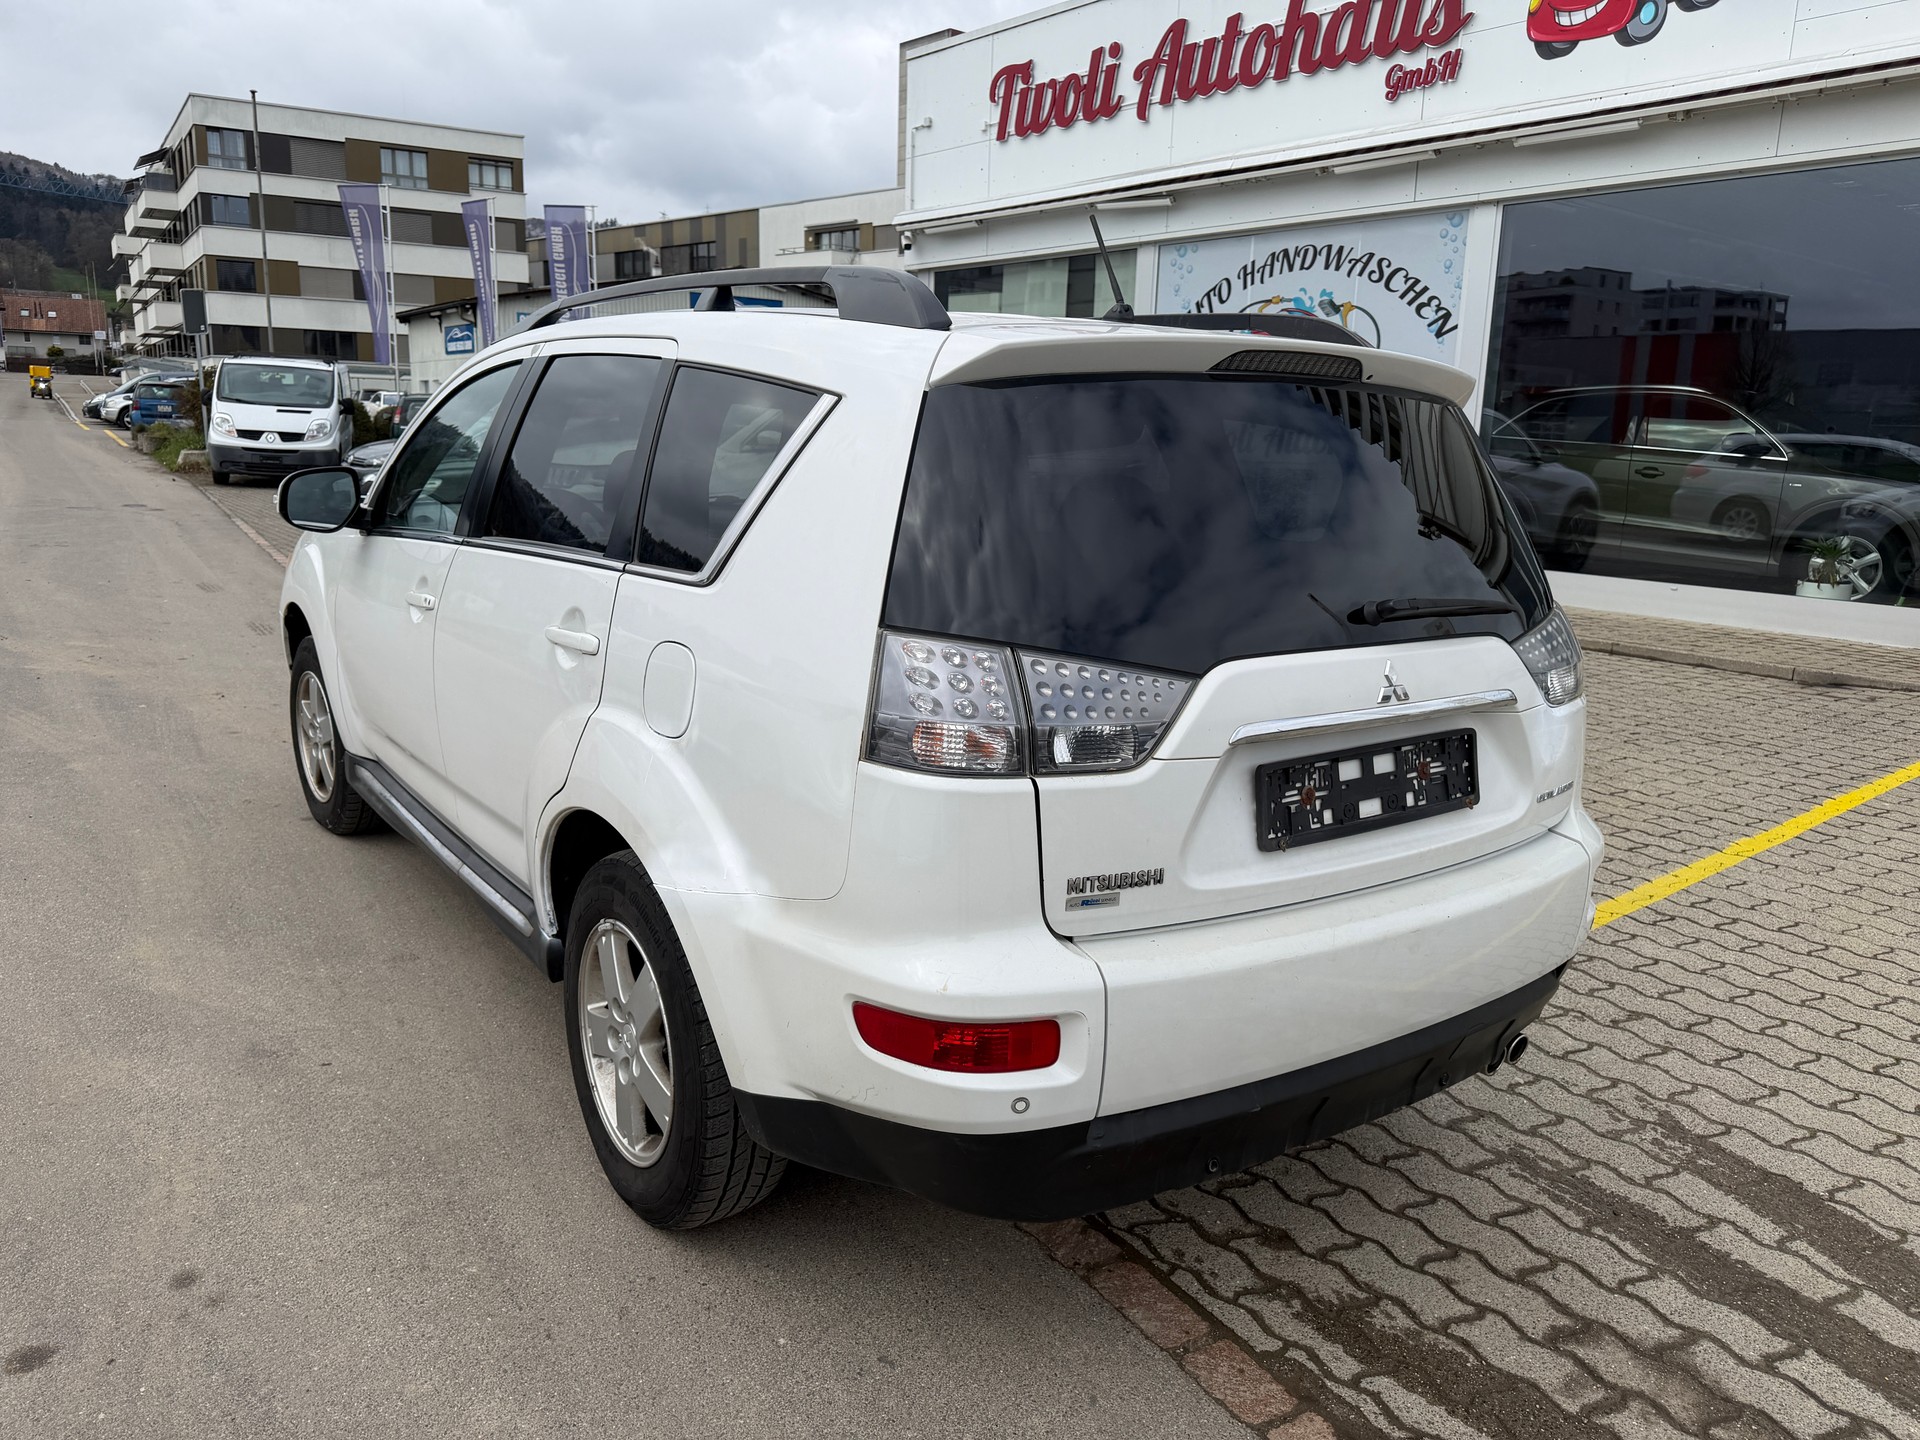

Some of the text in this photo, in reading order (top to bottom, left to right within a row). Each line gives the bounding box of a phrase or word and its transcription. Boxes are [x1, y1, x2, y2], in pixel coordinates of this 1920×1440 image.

[989, 0, 1475, 142] Tivoli Autohaus
[1384, 48, 1463, 103] GmbH
[1237, 243, 1459, 340] HANDWASCHEN
[1066, 867, 1165, 895] MITSUBISHI
